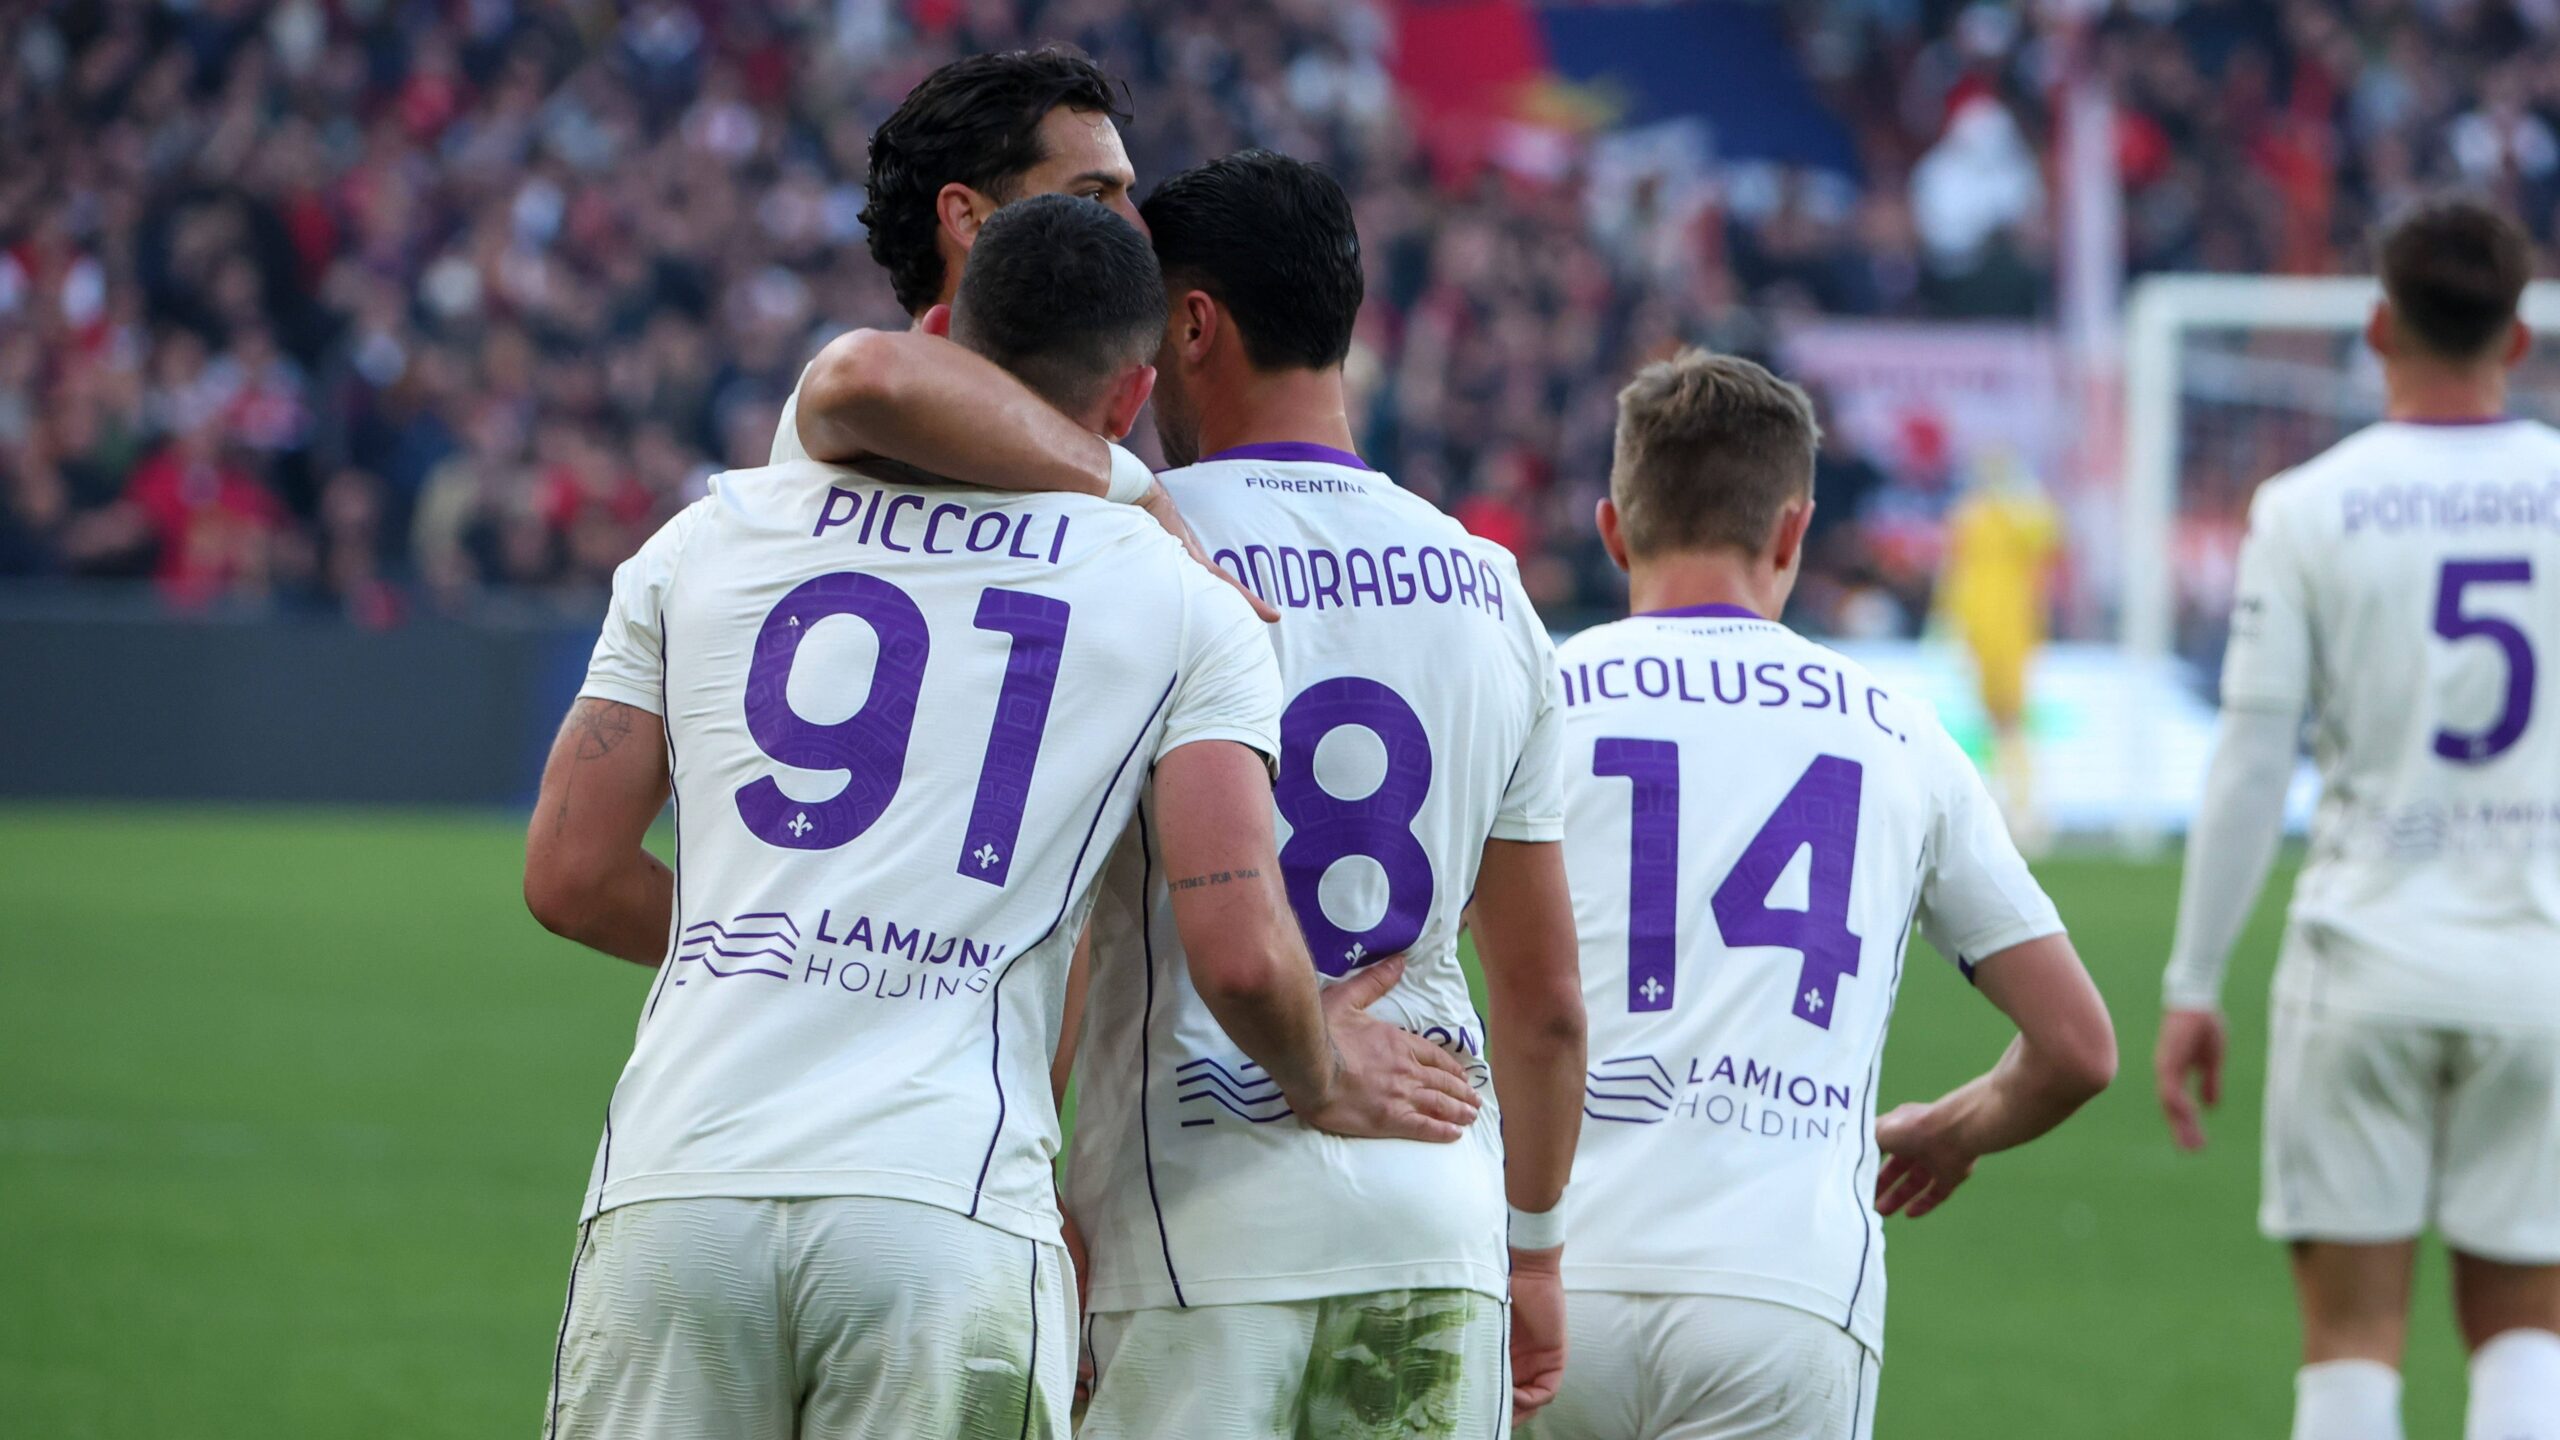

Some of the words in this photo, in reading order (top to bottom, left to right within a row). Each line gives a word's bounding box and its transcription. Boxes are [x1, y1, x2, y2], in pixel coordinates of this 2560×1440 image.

[811, 485, 1070, 565] PICCOLI
[1245, 477, 1368, 496] FIORENTINA
[1212, 544, 1504, 622] ONDRAGORA
[2433, 558, 2536, 766] 5
[734, 570, 1071, 888] 91
[1865, 686, 1907, 744] C.
[1273, 675, 1434, 978] 8
[1178, 875, 1206, 890] TIME
[1592, 736, 1864, 1030] 14
[1687, 1054, 1851, 1111] LAMION
